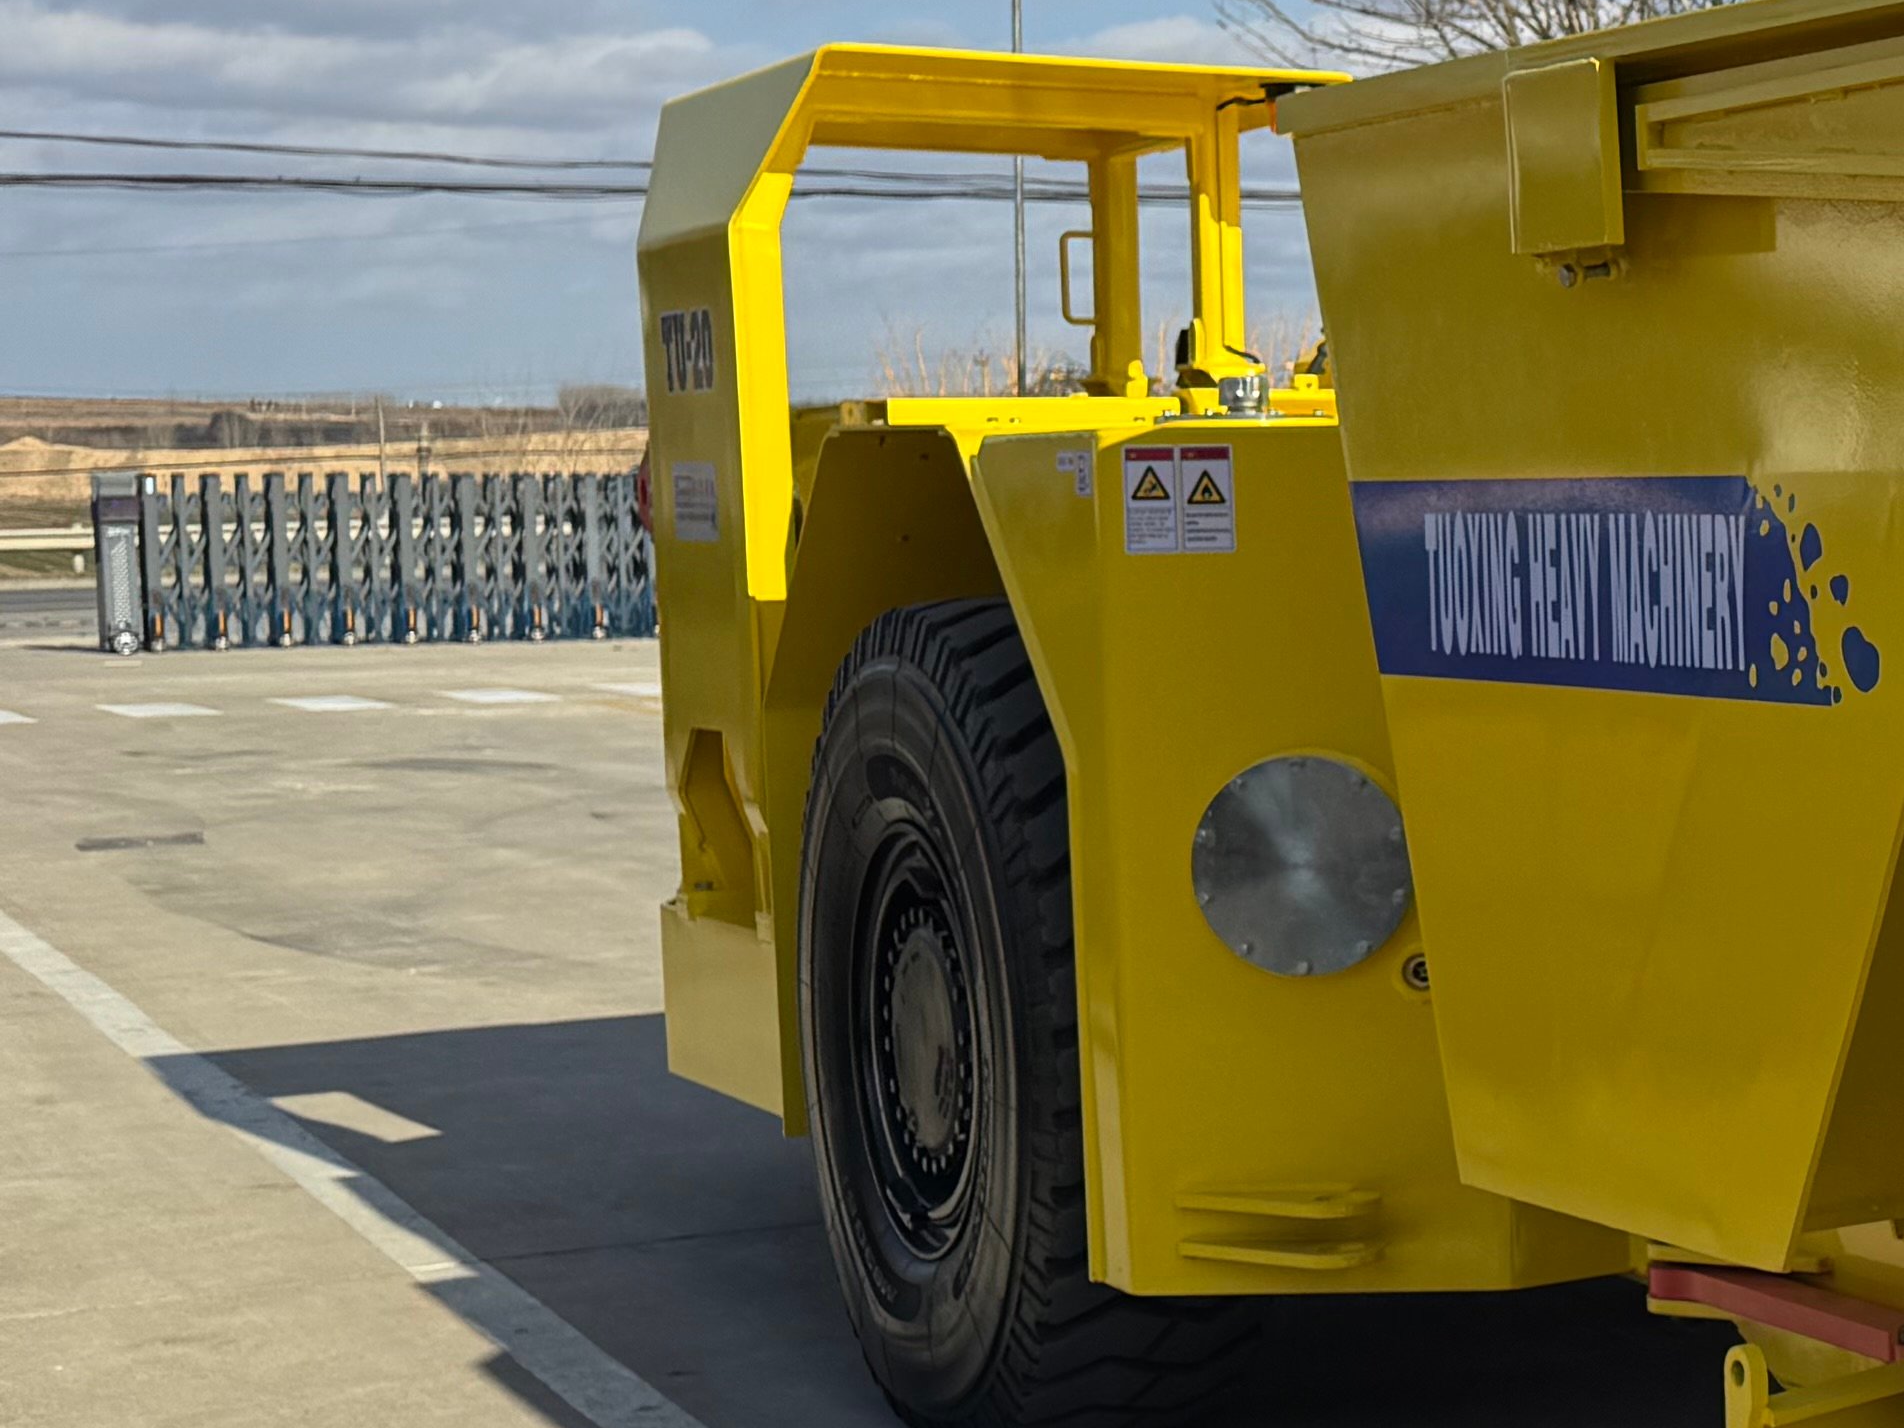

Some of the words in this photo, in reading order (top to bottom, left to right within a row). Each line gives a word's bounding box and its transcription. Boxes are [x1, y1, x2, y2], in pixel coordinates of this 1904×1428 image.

[660, 310, 714, 392] TU-20
[1424, 510, 1523, 658] TUOXING
[1527, 513, 1600, 662] HEAVY
[1608, 510, 1746, 671] MACHINERY
